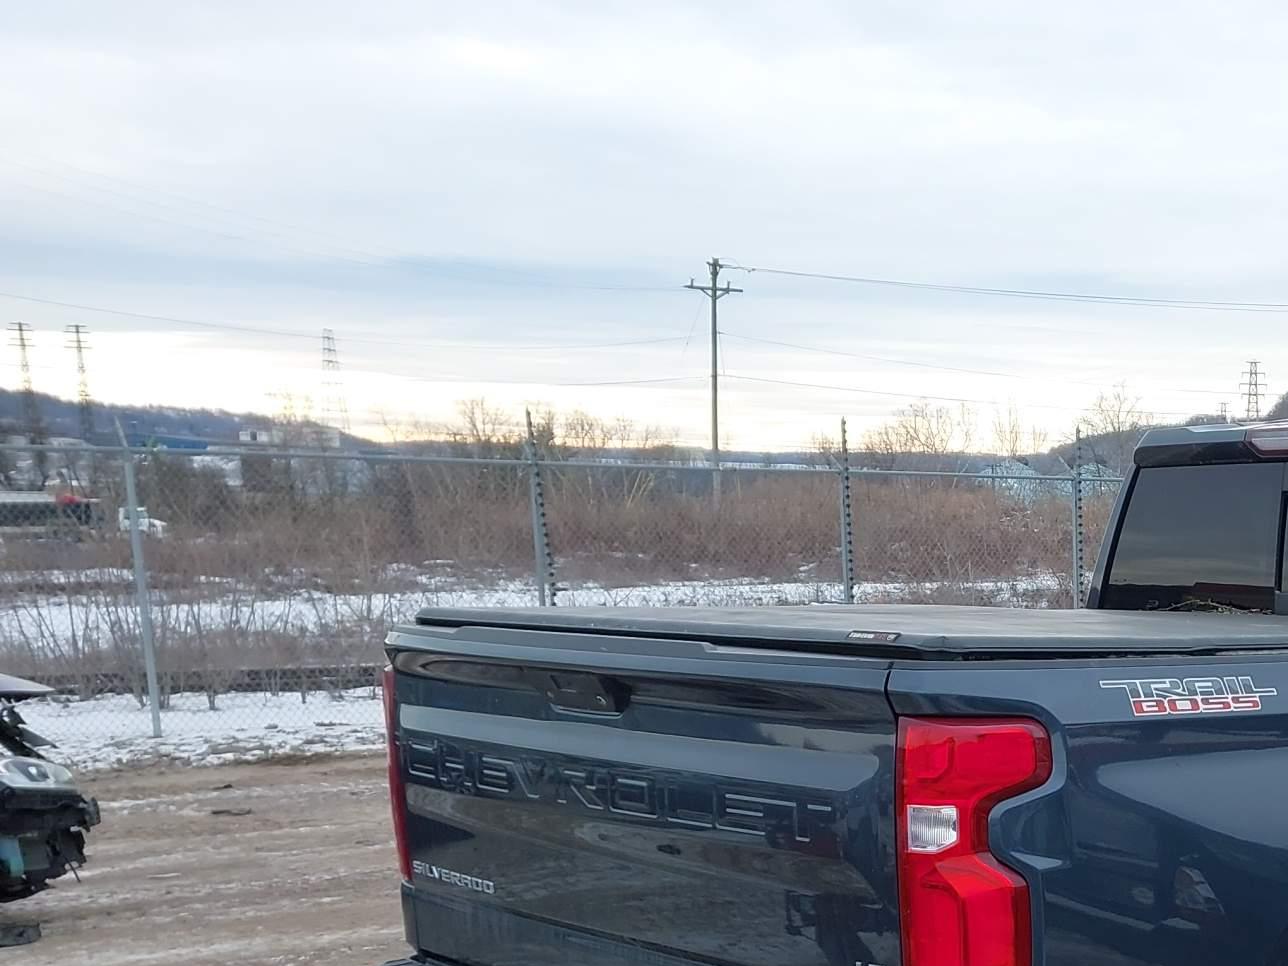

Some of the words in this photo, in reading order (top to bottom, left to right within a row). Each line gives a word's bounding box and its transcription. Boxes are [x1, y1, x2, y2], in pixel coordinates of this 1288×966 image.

[1099, 676, 1277, 699] TRAIL
[1132, 695, 1261, 716] BOSS
[405, 739, 834, 842] CHEVROLET
[412, 860, 495, 894] SILVERADO
